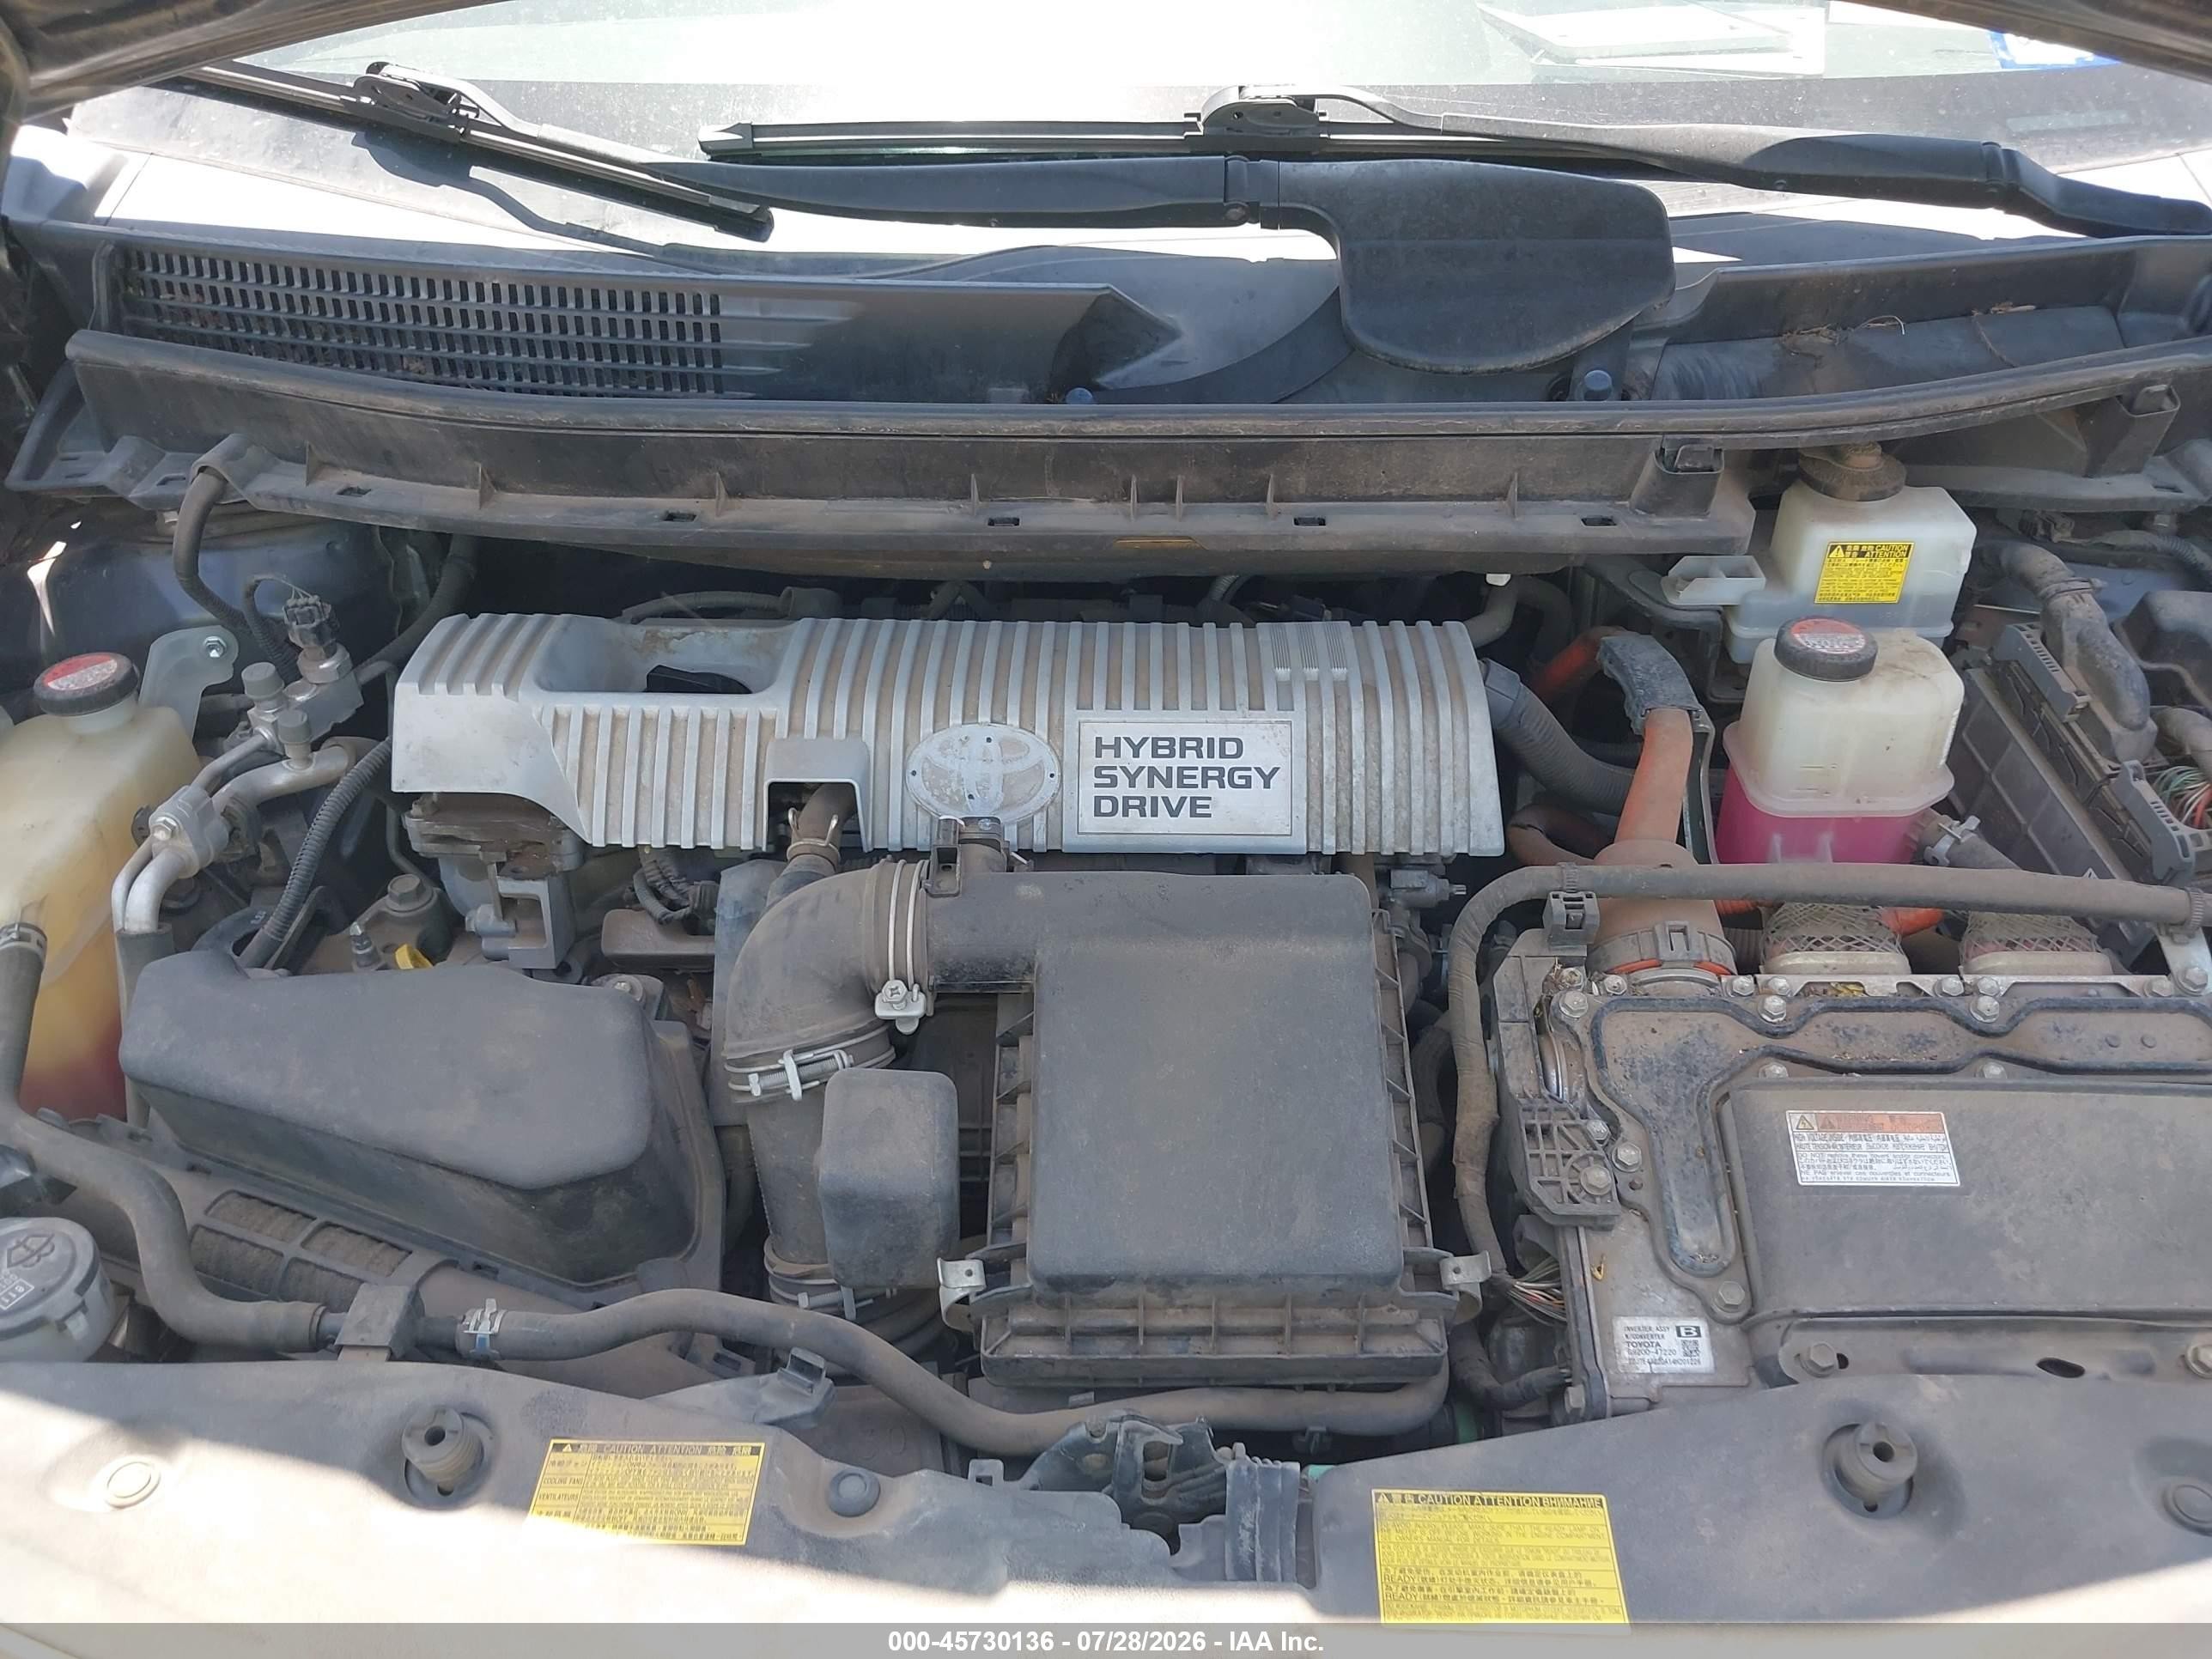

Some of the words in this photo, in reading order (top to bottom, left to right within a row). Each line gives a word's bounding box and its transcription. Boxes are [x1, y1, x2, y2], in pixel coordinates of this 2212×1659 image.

[1095, 736, 1243, 760] HYBRID
[1094, 766, 1280, 789] SYNERGY
[1094, 795, 1212, 818] DRIVE
[604, 1444, 644, 1454] CAUTION
[1418, 1493, 1470, 1505] CAUTION
[1474, 1494, 1540, 1507] ATTENTION
